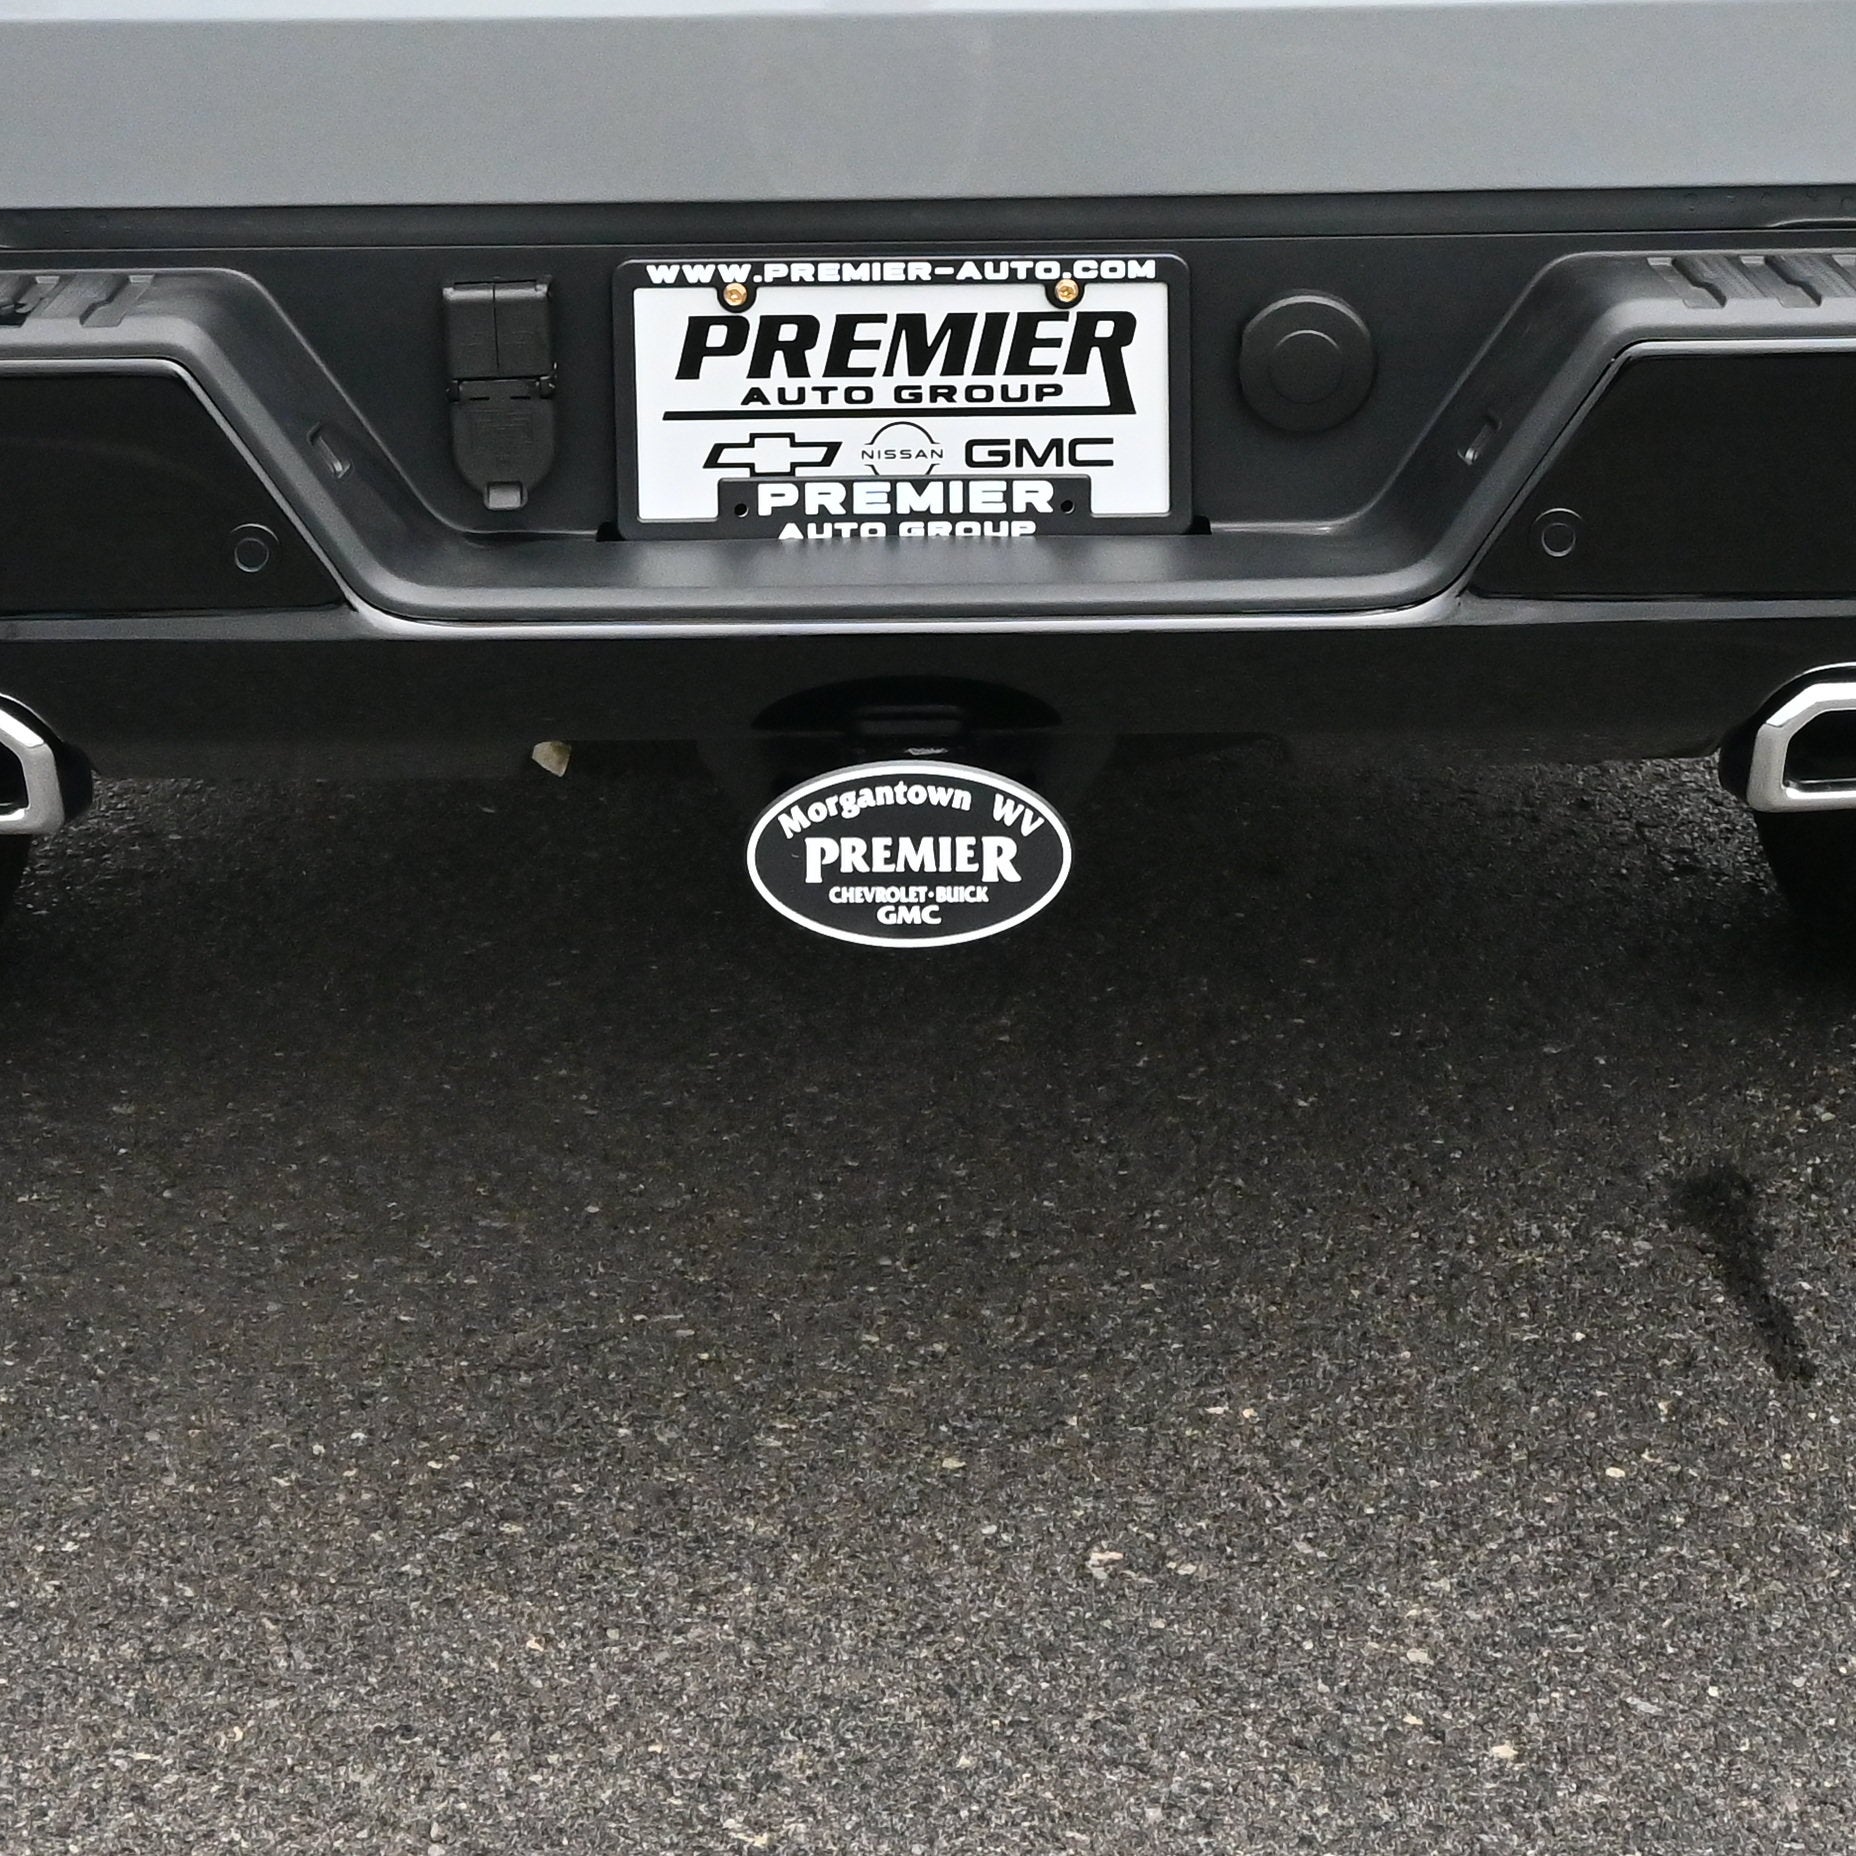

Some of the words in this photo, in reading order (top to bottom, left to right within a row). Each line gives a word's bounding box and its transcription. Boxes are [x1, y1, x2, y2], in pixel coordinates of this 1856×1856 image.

[645, 259, 1156, 285] WWW.PREMIER-AUTO.COM
[674, 310, 1137, 415] PREMIER
[740, 385, 874, 406] AUTO
[893, 383, 1064, 404] GROUP
[860, 448, 944, 460] NISSAN
[964, 437, 1115, 468] GMC
[756, 480, 1055, 517] PREMIER
[777, 522, 887, 540] AUTO
[898, 520, 1037, 538] GROUP
[776, 779, 973, 840] Morgantown
[992, 792, 1045, 838] WV
[804, 835, 1023, 884] PREMIER
[876, 905, 942, 925] GMC
